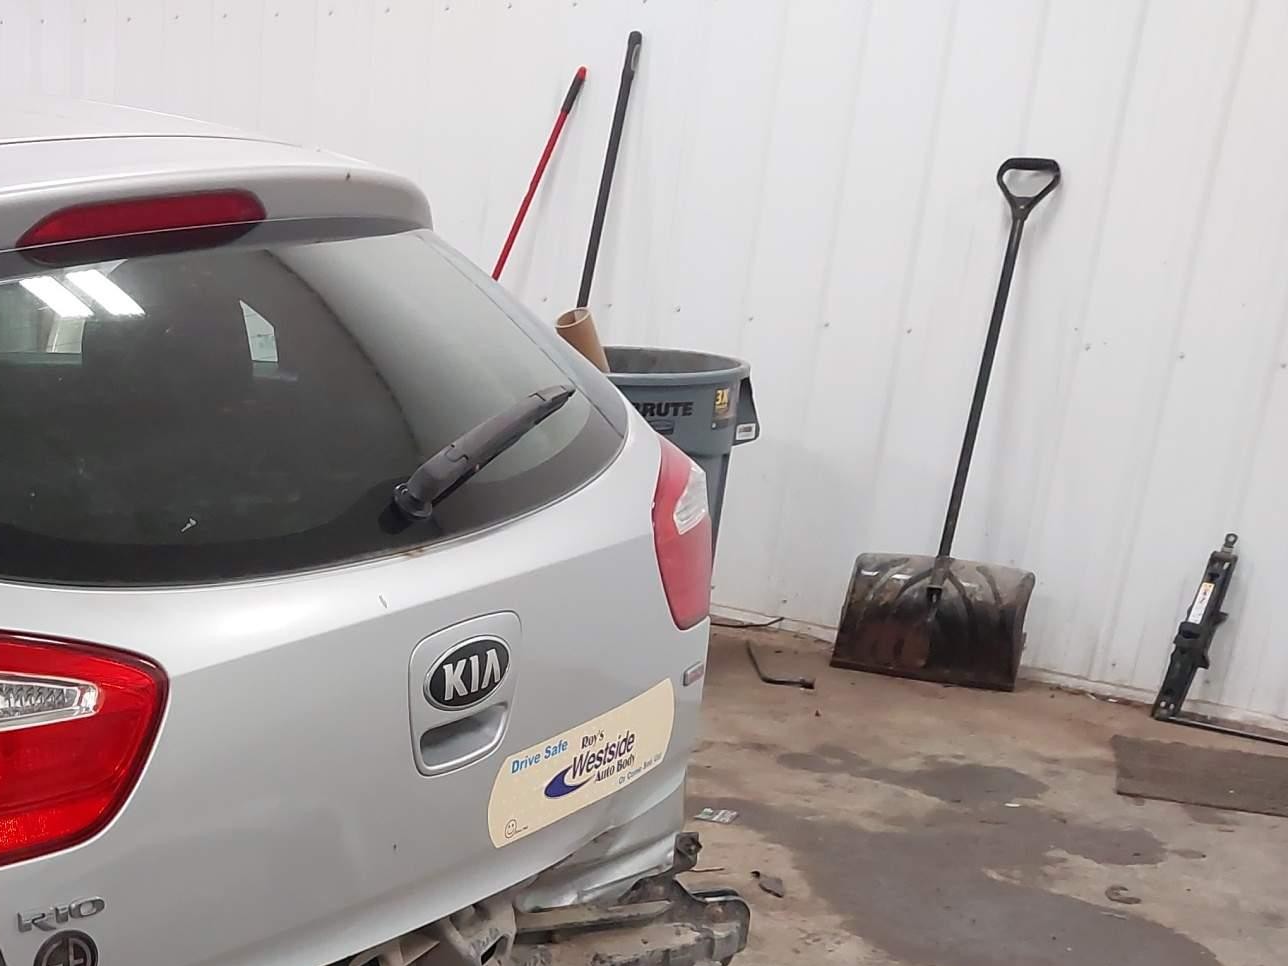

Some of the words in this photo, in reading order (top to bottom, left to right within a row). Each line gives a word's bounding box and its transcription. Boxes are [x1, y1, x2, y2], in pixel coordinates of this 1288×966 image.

[443, 648, 501, 701] KIA
[511, 752, 541, 774] Drive
[544, 739, 569, 760] Safe
[571, 730, 636, 779] Westside
[594, 765, 615, 782] Auto
[616, 753, 636, 772] Body
[17, 896, 106, 933] RIO
